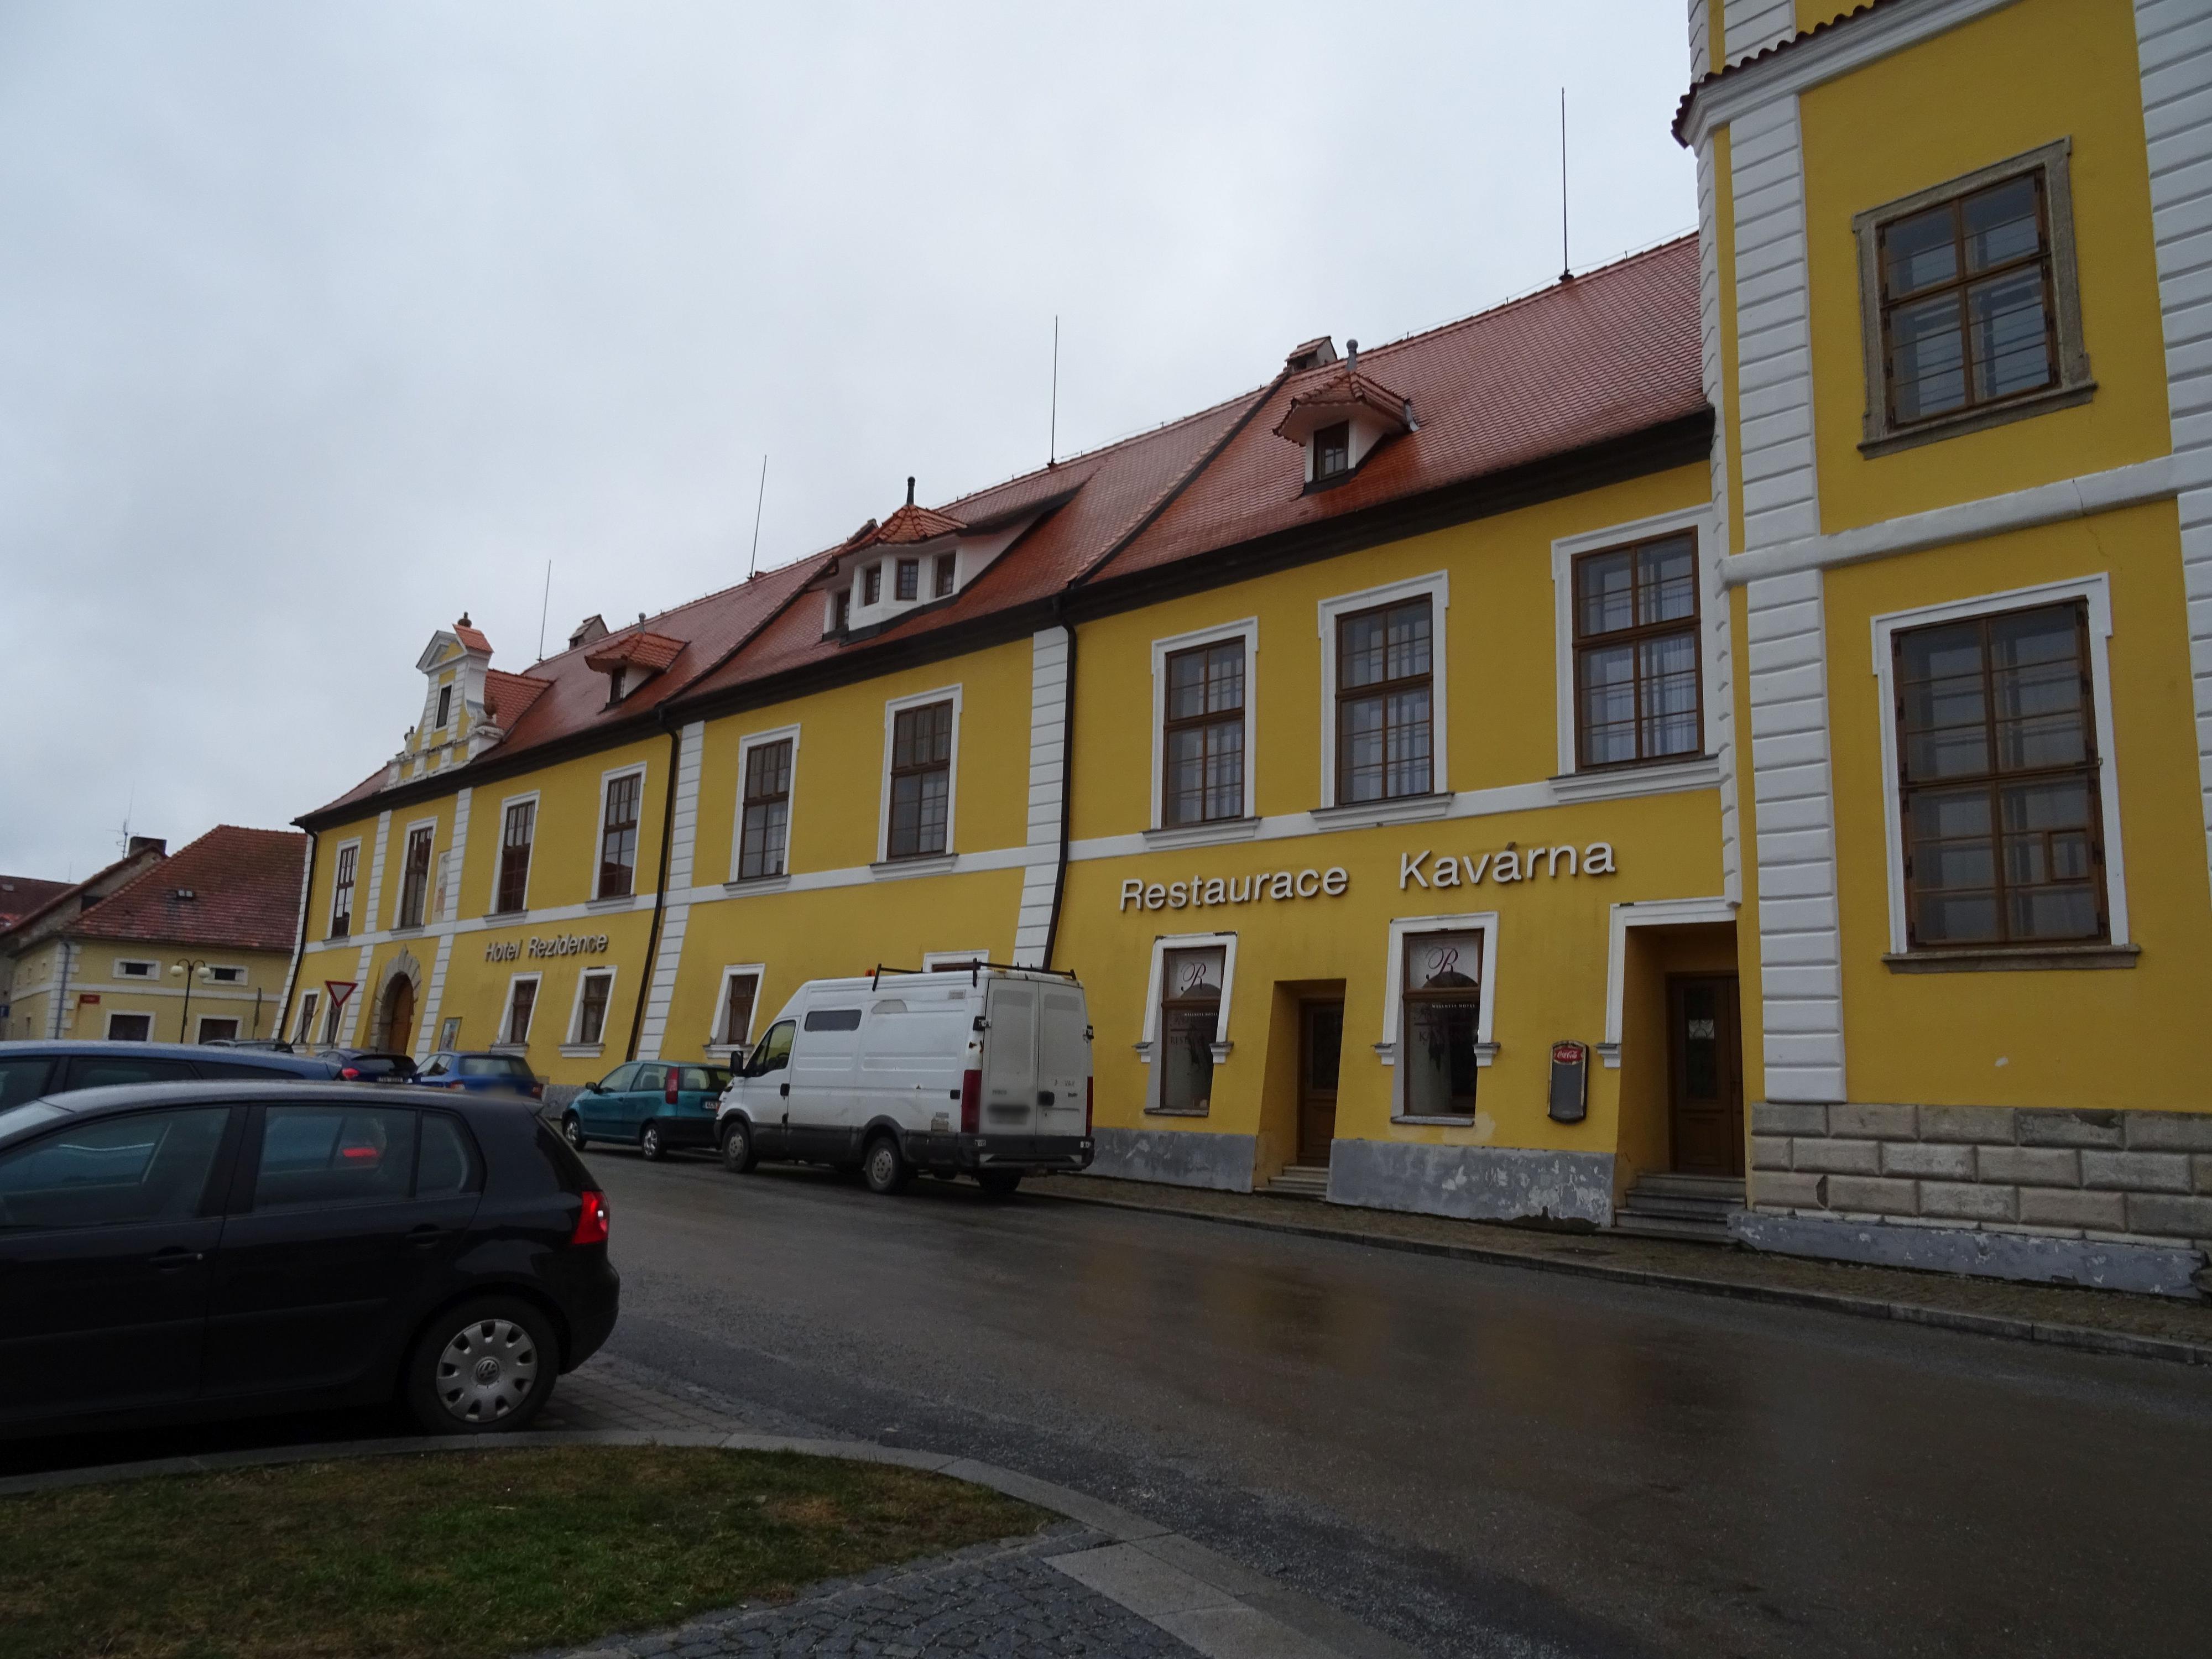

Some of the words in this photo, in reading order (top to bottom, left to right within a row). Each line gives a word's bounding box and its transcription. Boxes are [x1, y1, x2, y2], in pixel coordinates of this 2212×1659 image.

[1399, 842, 1615, 889] Kavárna
[1120, 867, 1348, 911] Restaurace
[485, 940, 523, 962] Hotel
[528, 933, 608, 957] Rezidence
